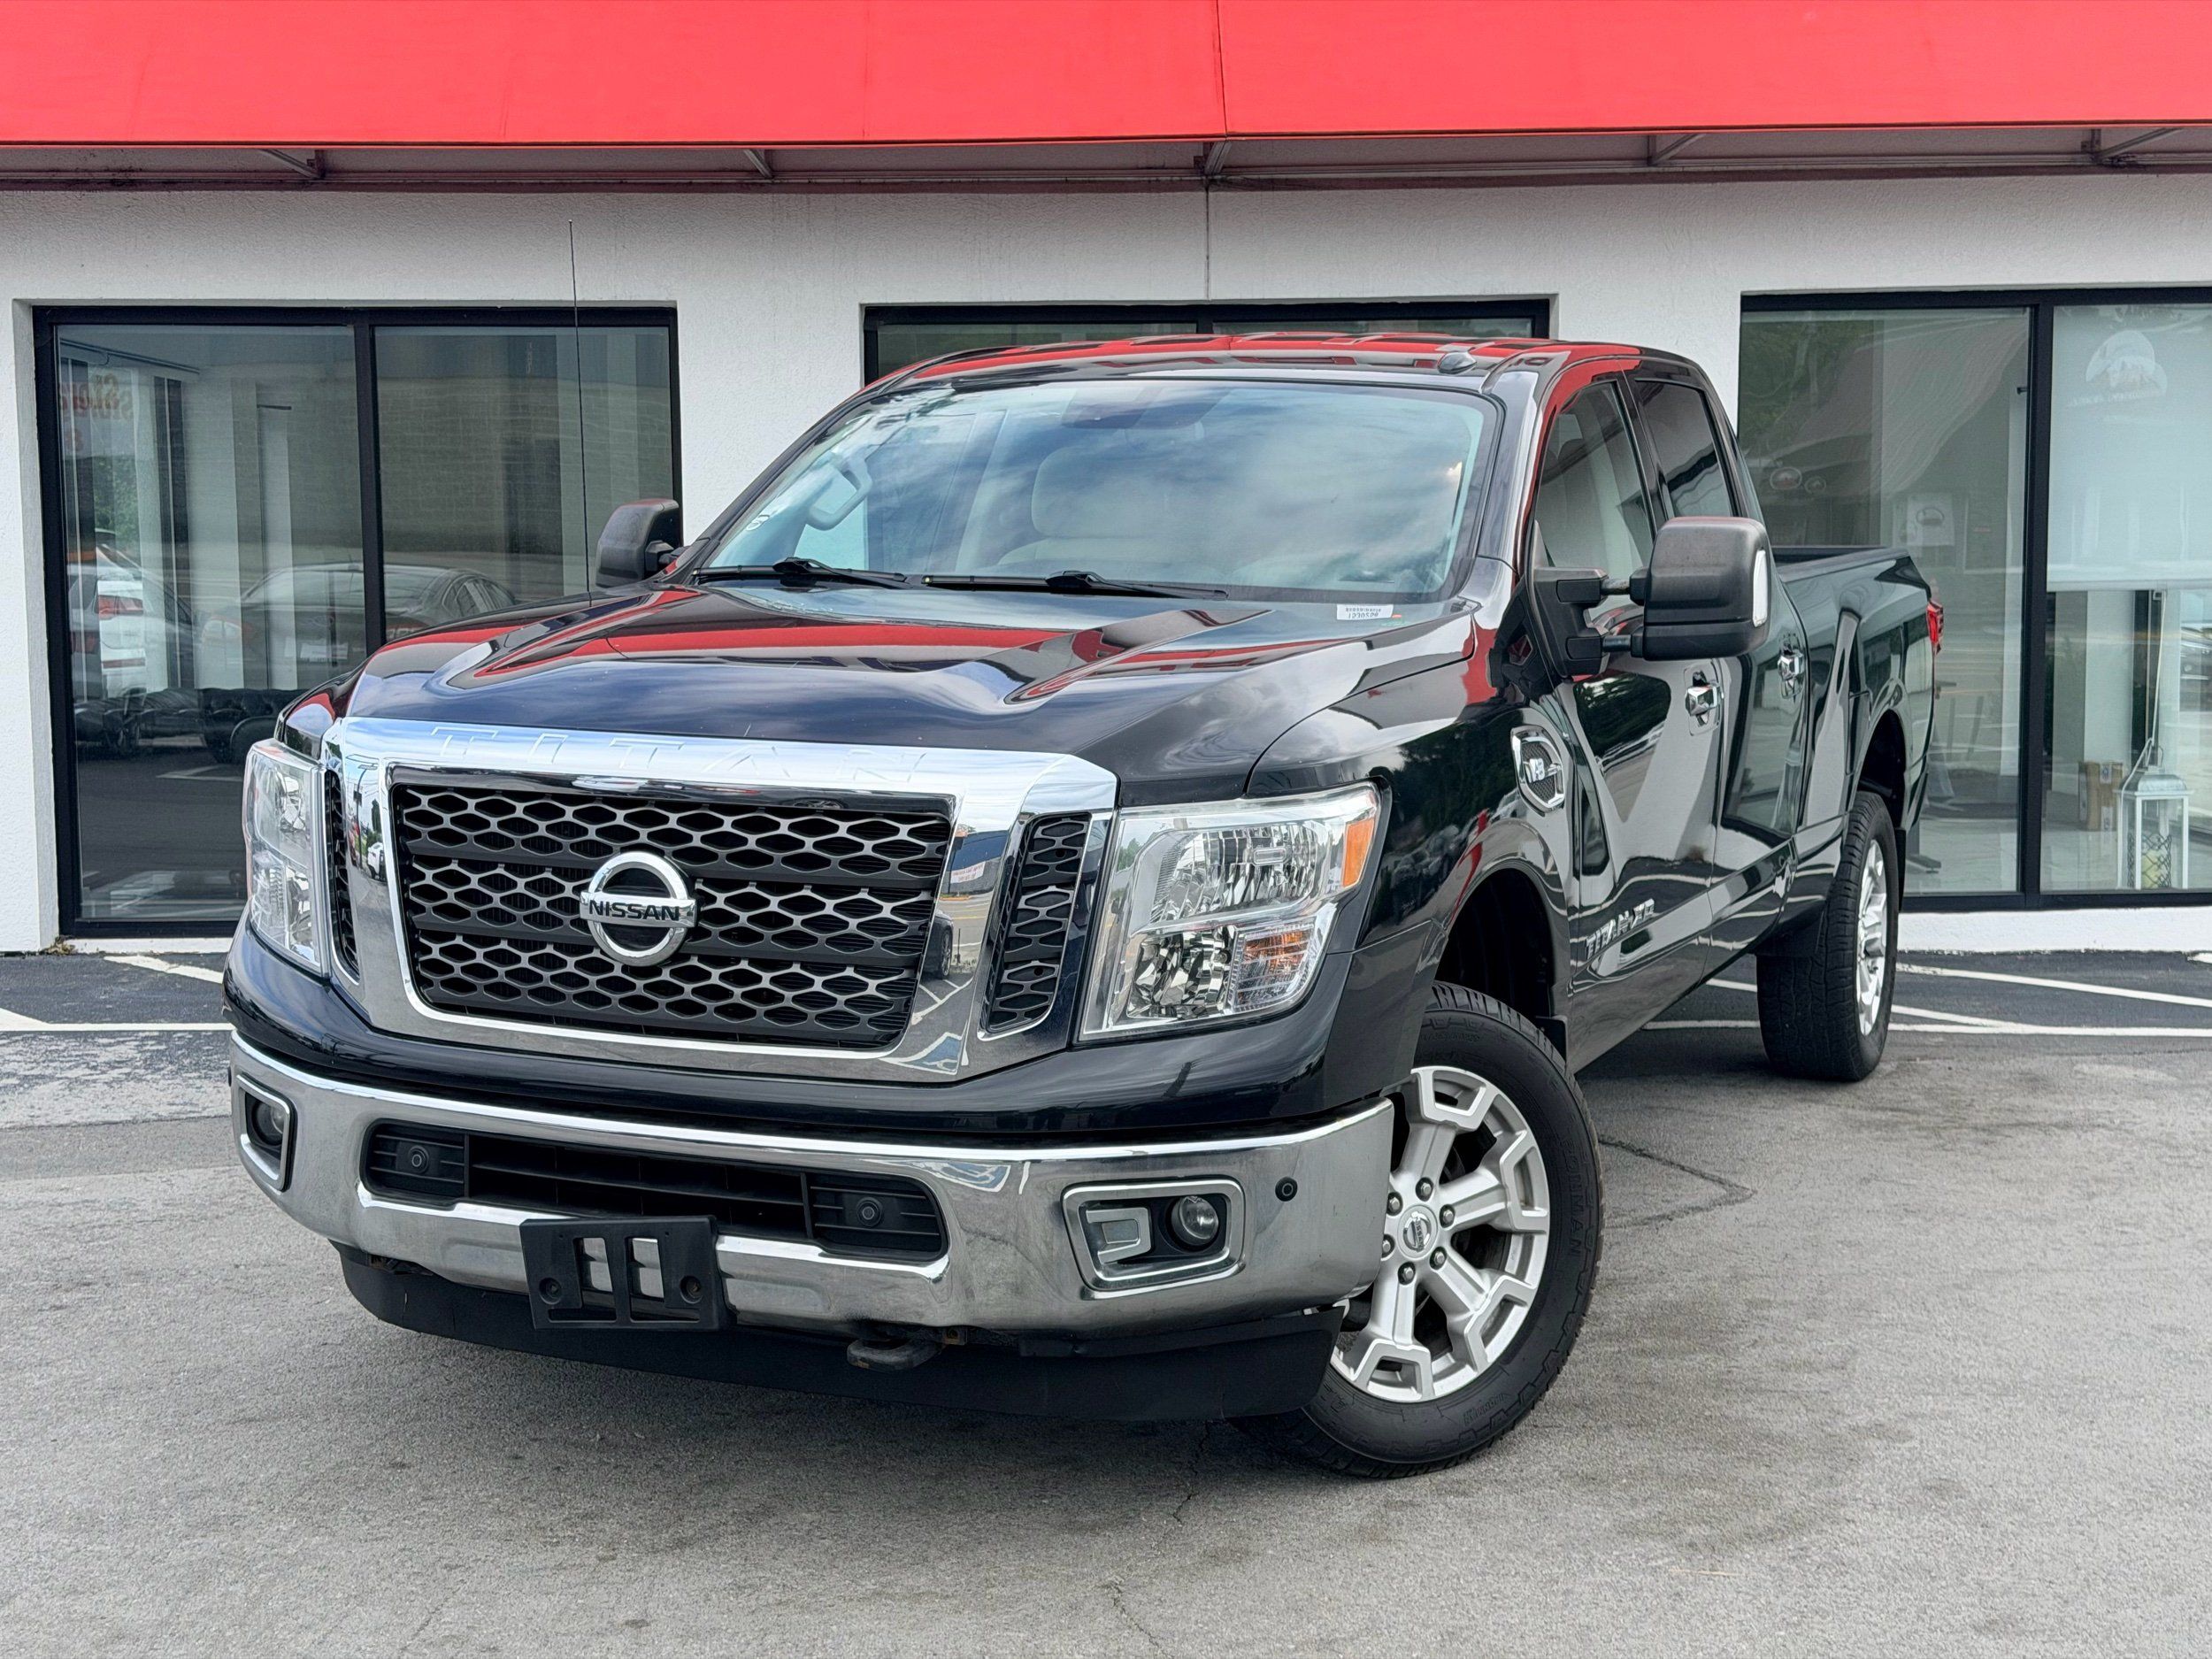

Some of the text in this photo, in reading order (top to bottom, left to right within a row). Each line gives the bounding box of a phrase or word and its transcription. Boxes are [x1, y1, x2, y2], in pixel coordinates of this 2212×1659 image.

[430, 726, 927, 783] TITAN
[588, 899, 680, 921] NISSAN
[1586, 918, 1630, 961] TITAN
